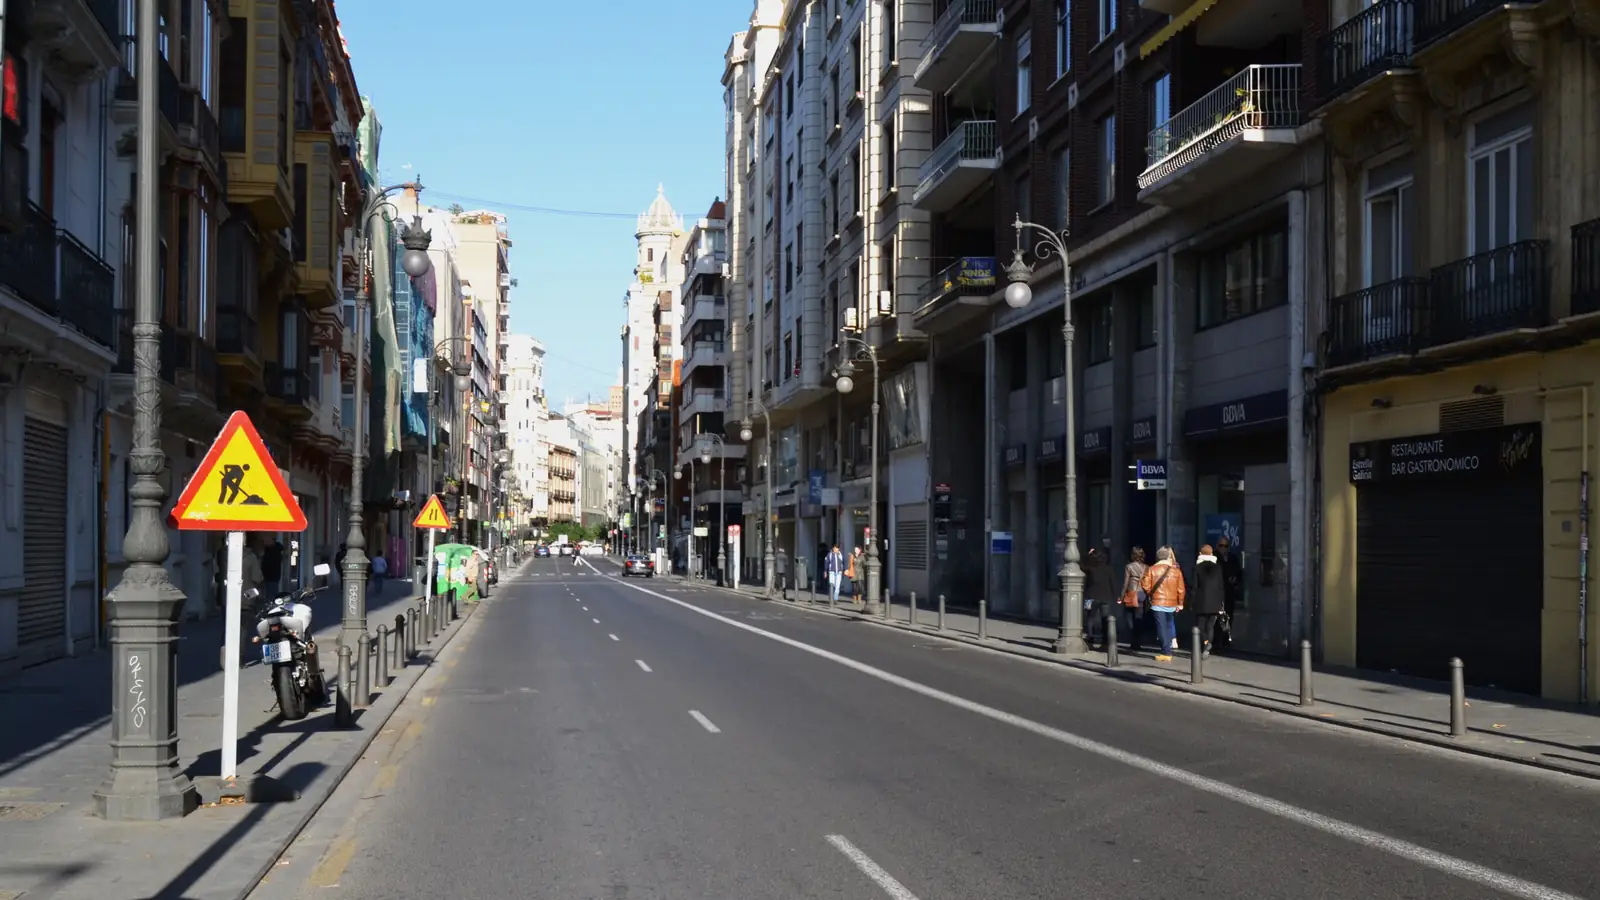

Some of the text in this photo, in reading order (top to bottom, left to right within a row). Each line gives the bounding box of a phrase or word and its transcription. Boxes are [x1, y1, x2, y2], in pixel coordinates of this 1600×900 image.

[1223, 403, 1246, 424] BBVA
[1133, 420, 1152, 439] BBVA
[1084, 431, 1100, 448] BBVA
[1391, 439, 1444, 457] RESTAURANTE
[1141, 465, 1165, 474] BBVA
[1391, 456, 1479, 476] BAR GASTRONOMICO
